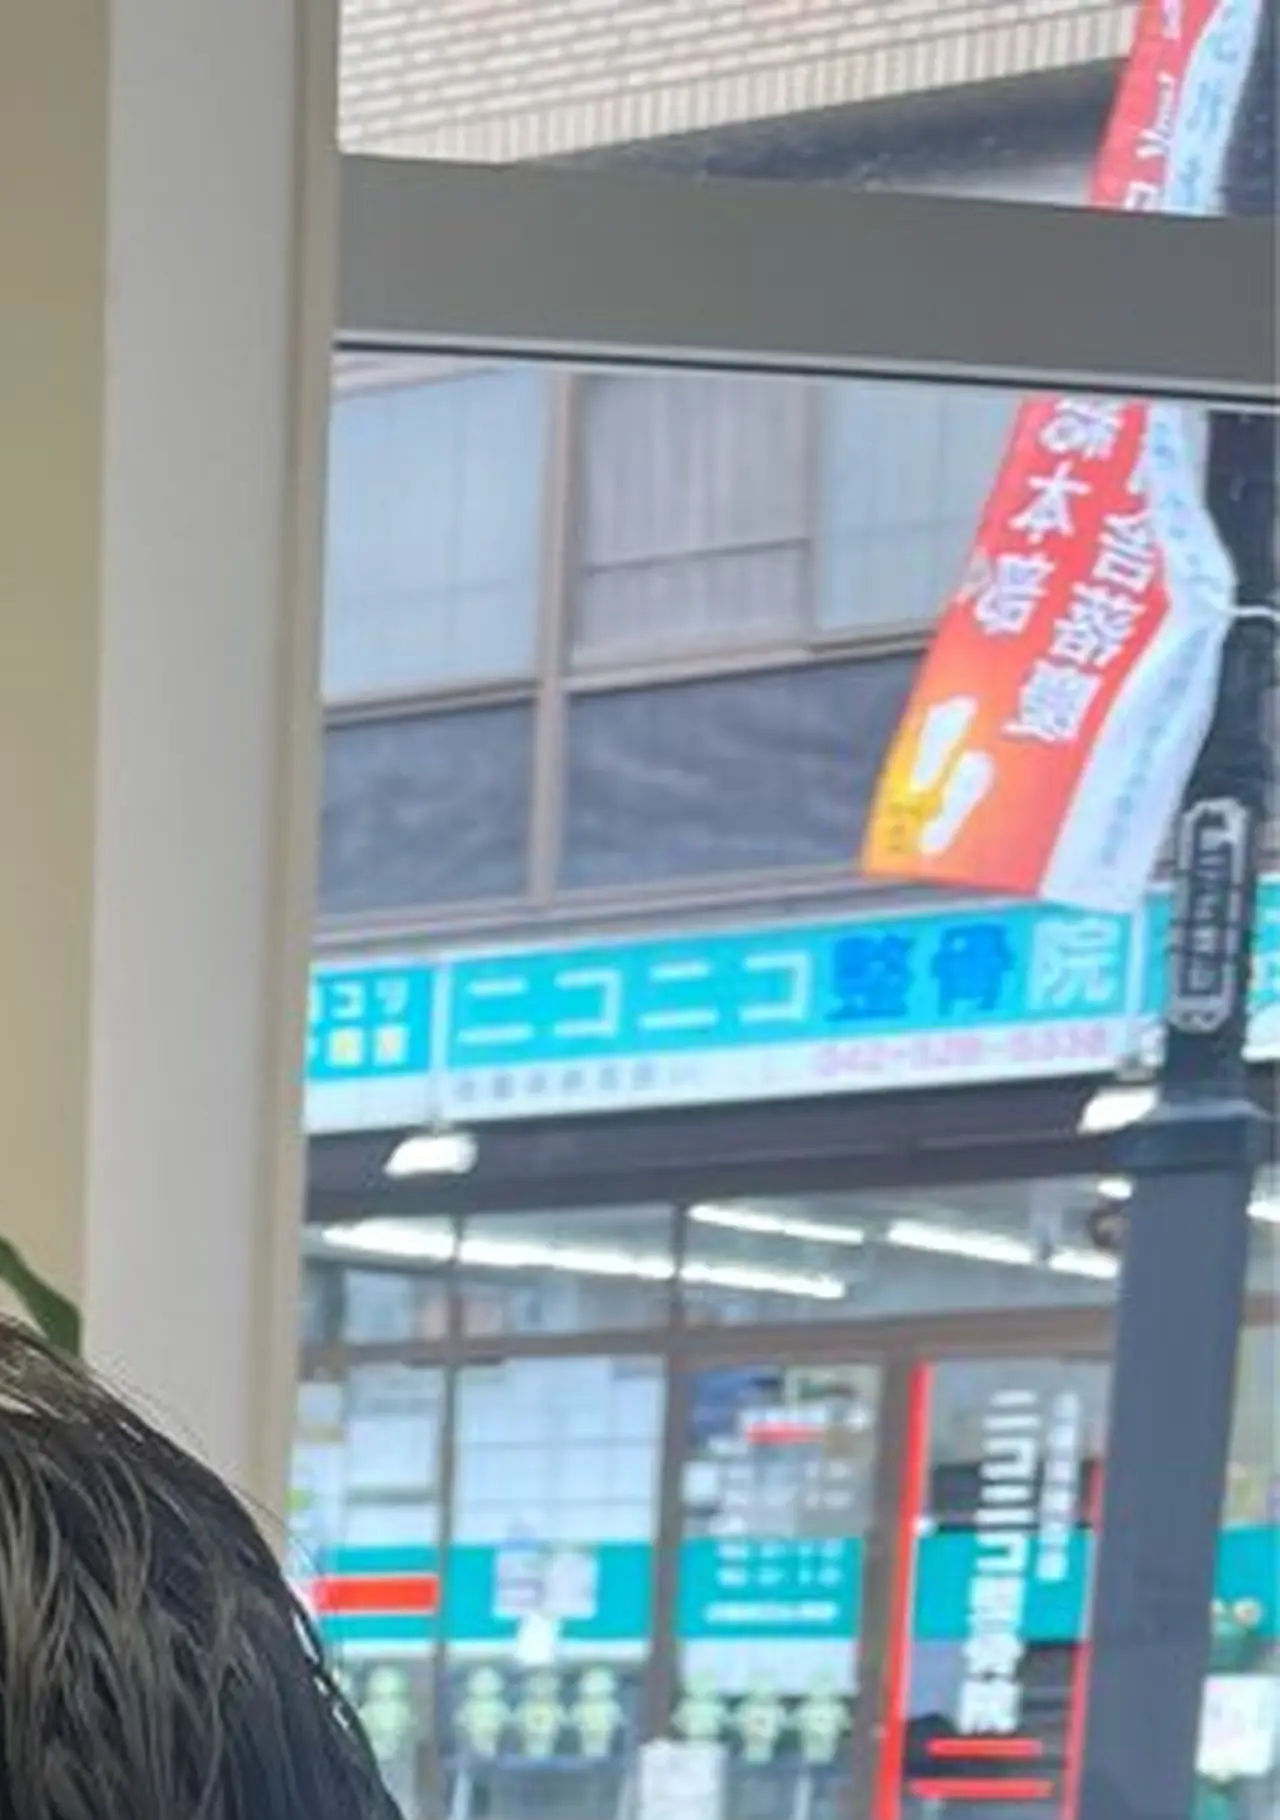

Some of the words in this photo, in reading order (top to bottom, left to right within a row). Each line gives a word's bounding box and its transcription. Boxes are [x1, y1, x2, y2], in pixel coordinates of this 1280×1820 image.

[456, 915, 1123, 1046] ニコニコ整骨院
